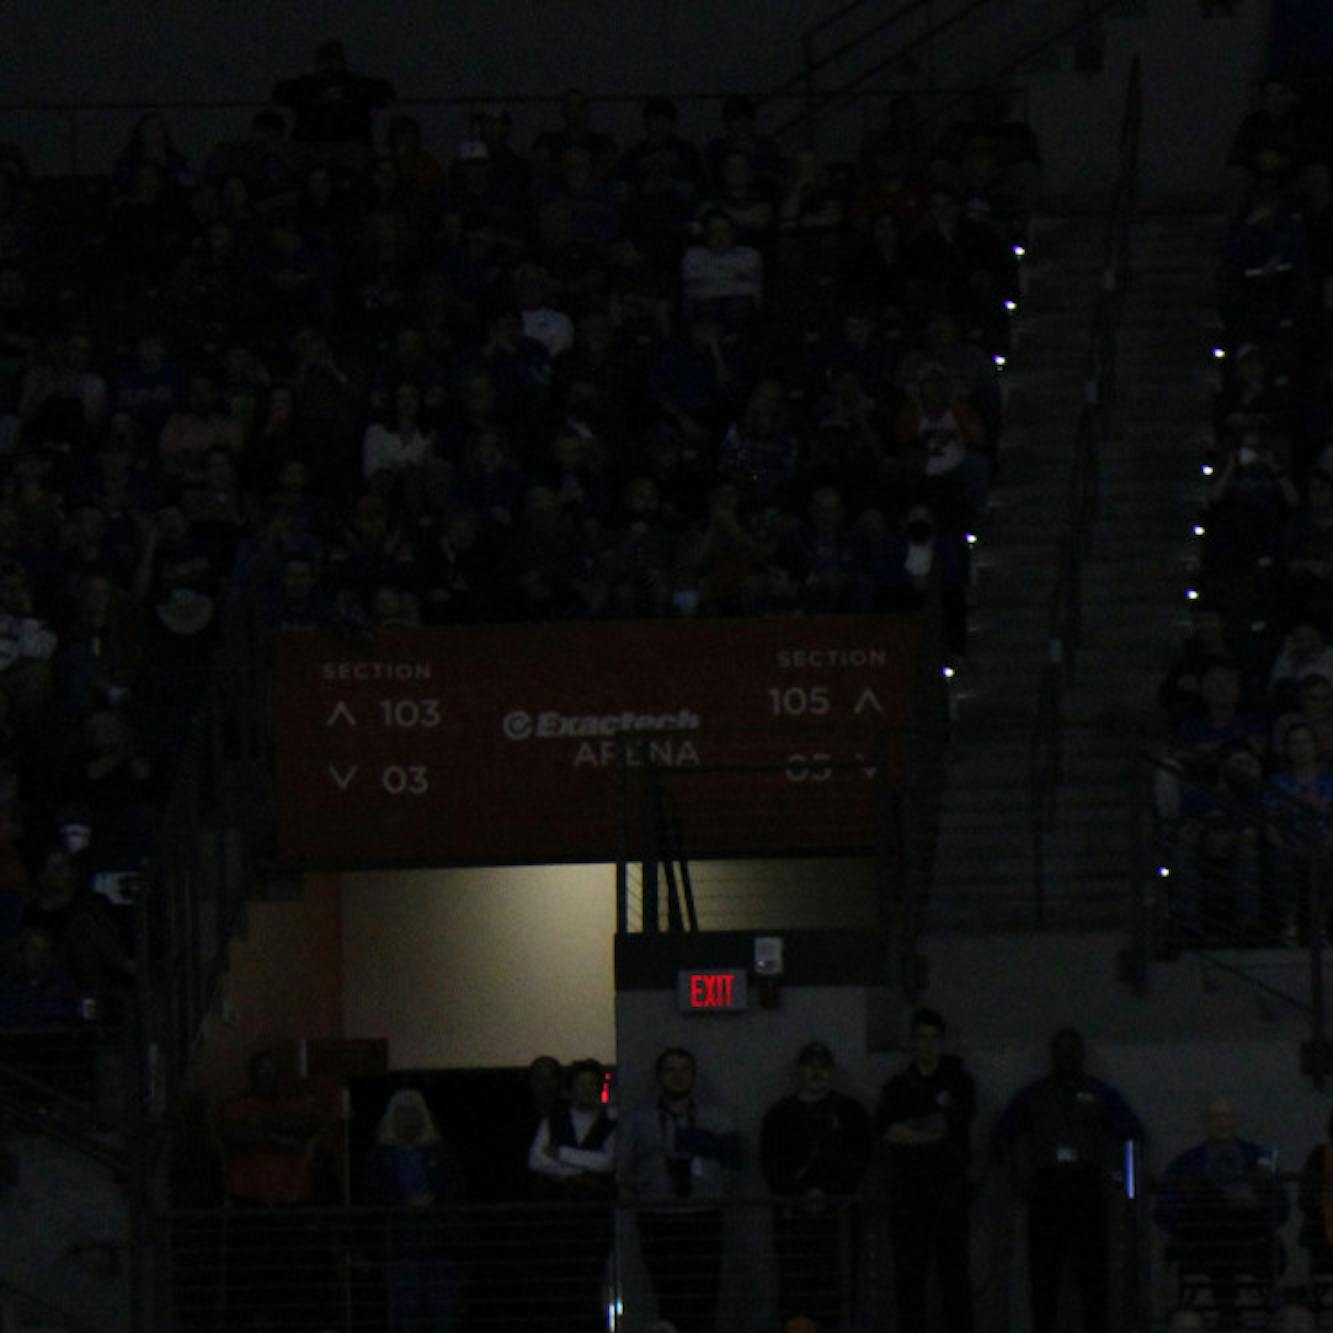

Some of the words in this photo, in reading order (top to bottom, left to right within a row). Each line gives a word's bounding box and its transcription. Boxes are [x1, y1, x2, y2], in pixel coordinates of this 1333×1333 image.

[320, 662, 432, 680] SECTION
[776, 650, 887, 669] SECTION
[380, 699, 442, 728] 103
[768, 686, 831, 716] 105
[534, 708, 700, 737] Exactech
[382, 765, 430, 795] 03
[690, 974, 735, 1008] EXIT
